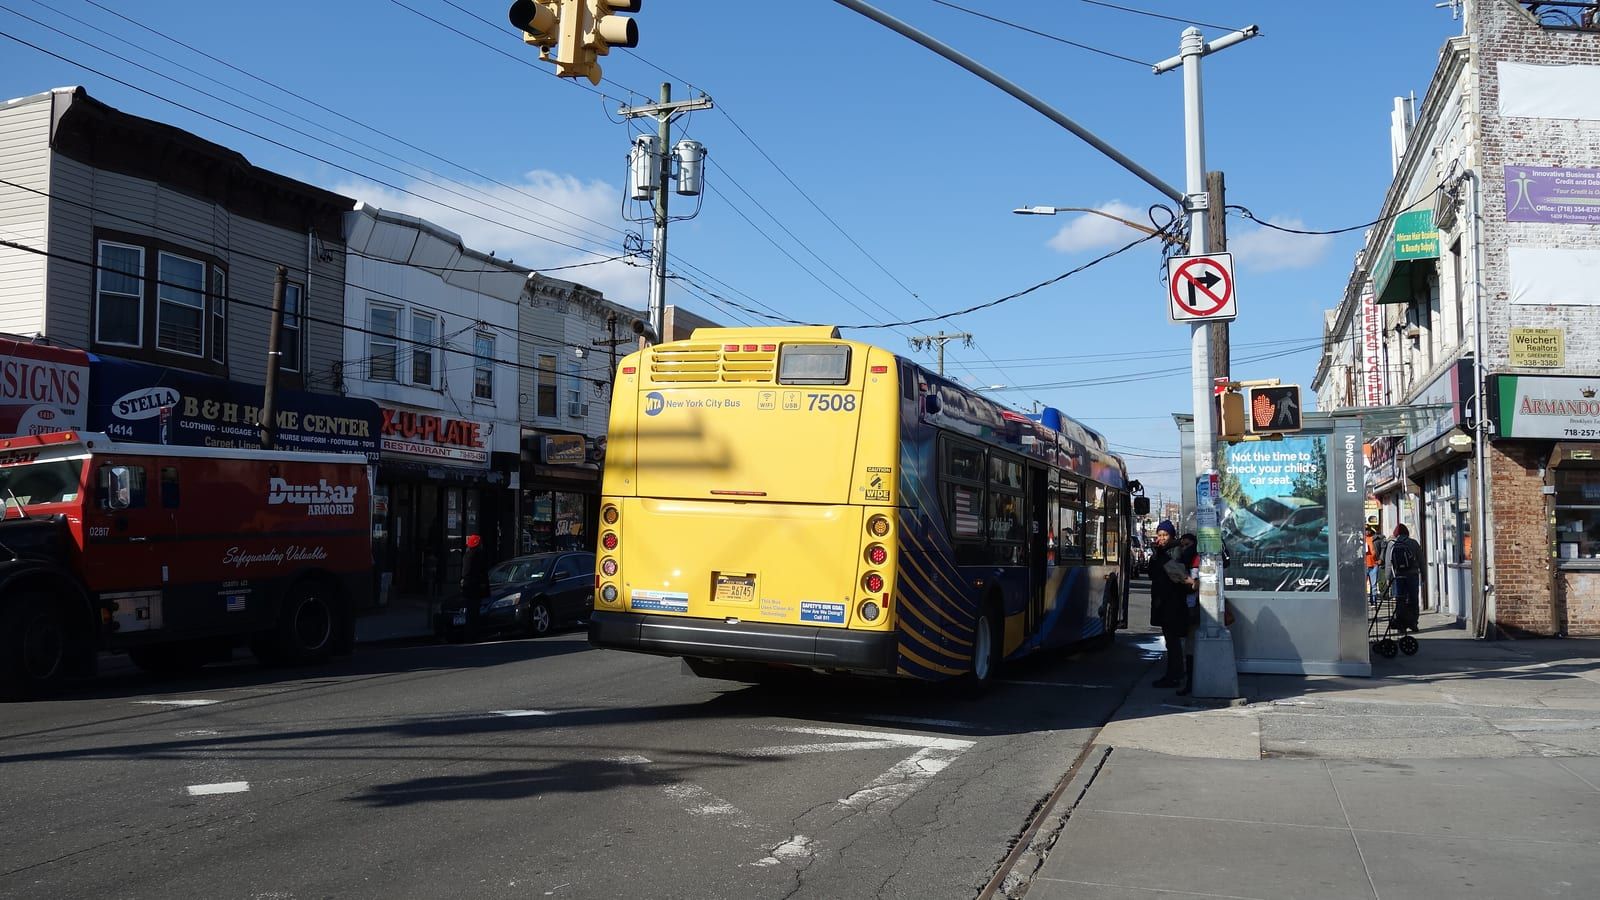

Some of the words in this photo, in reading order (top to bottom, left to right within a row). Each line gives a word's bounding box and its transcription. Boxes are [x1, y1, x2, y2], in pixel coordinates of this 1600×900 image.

[1515, 335, 1557, 344] Weichert
[1526, 344, 1558, 352] Realtors
[0, 360, 80, 406] SIGNS
[119, 390, 177, 415] STELLA
[666, 400, 684, 408] New
[685, 400, 704, 408] York
[705, 398, 724, 410] City
[725, 399, 741, 407] Bus
[807, 393, 856, 412] 7508
[107, 423, 134, 437] 1414
[303, 412, 370, 438] CENTER
[180, 420, 216, 432] CLOTHING
[221, 426, 252, 437] LUGGAGE
[280, 433, 300, 443] NURSE
[301, 435, 327, 444] UNIFORM
[330, 438, 359, 447] FOOTWEAR
[383, 440, 452, 457] RESTAURANT
[1231, 452, 1252, 462] Not
[1254, 452, 1271, 461] the
[1273, 451, 1297, 461] time
[1299, 452, 1311, 461] to
[1345, 434, 1358, 493] Newsstand
[1226, 463, 1257, 474] check
[1259, 464, 1283, 475] your
[1284, 462, 1317, 473] child's
[1249, 476, 1266, 485] car
[1269, 475, 1293, 485] seat.
[268, 477, 358, 504] Dunbar
[307, 504, 355, 516] ARMORED
[89, 526, 110, 537] 02817
[222, 546, 285, 567] Safeguarding
[286, 545, 328, 561] Valuables
[736, 586, 751, 597] 6745
